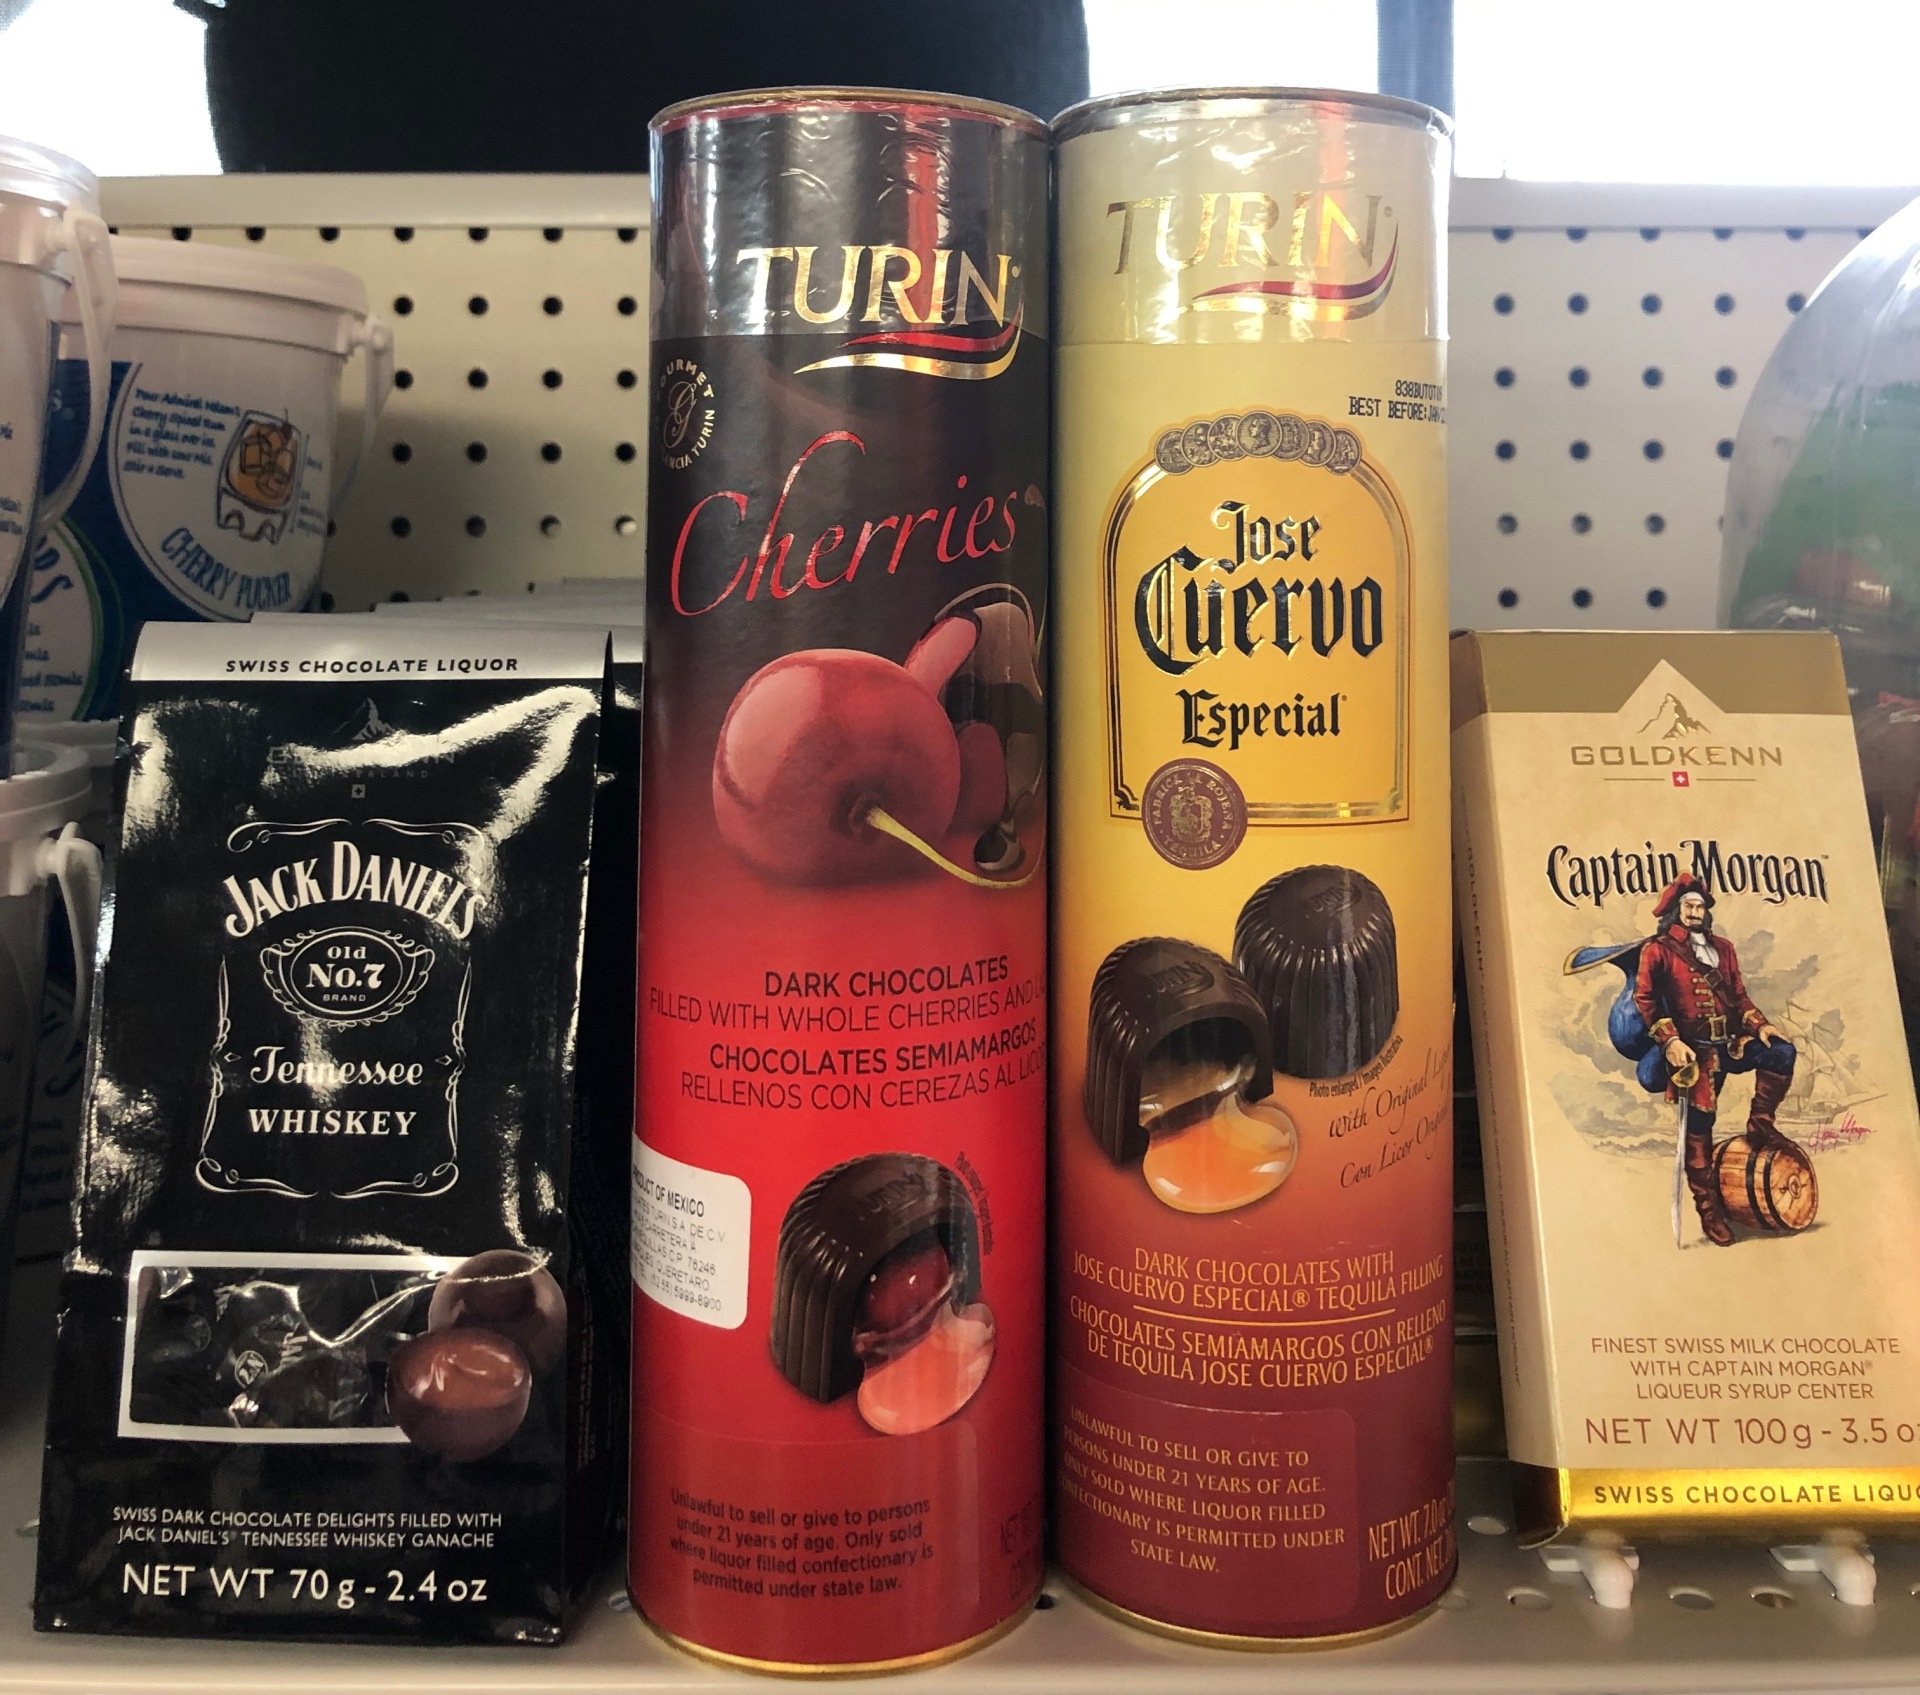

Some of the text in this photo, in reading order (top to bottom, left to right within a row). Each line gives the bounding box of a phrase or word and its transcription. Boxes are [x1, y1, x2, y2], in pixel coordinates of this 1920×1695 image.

[736, 244, 1013, 328] TURIN
[1349, 396, 1380, 418] BEST
[672, 430, 1017, 616] Cherries
[1210, 500, 1322, 574] Jose
[161, 527, 238, 601] CHERRY
[1134, 543, 1384, 676] Cuervo
[226, 658, 519, 673] SWISS CHOCOLATE LIQUOR
[1174, 689, 1341, 751] Especial
[1571, 745, 1783, 767] GOLDKENN
[1545, 839, 1828, 909] Captain Morgan
[222, 857, 327, 937] JACK
[327, 945, 367, 960] Old
[306, 963, 386, 989] No.7
[765, 972, 840, 997] DARK
[849, 955, 1008, 997] CHOCOLATES
[323, 994, 367, 1002] BRAND
[651, 987, 701, 1022] FILLED
[708, 1002, 768, 1030] WITH
[778, 1005, 879, 1032] WHOLE
[888, 990, 999, 1030] CHERRIES
[1003, 979, 1033, 1013] AND
[251, 1046, 424, 1085] Tennessee
[710, 1017, 1037, 1075] CHOCOLATES SEMIAMARGOS
[681, 1065, 1015, 1110] RELLENOS CON CEREZAS AL
[1309, 1081, 1330, 1098] Photo
[249, 1109, 418, 1135] WHISKEY
[655, 1184, 665, 1201] OF
[668, 1191, 705, 1217] MEXICO
[1073, 1250, 1104, 1285] JOSE
[1109, 1266, 1185, 1304] CUERVO
[1315, 1277, 1397, 1311] TEQUILA
[1401, 1254, 1443, 1295] FILLING
[1134, 1247, 1394, 1285] DARK CHOCOLATES WITH
[1070, 1295, 1447, 1360] CHOCOLATES SEMIAMARGOS CON RELLENO
[1591, 1338, 1900, 1354] FINEST SWISS MILK CHOCOLATE
[1088, 1329, 1109, 1358] DE
[1112, 1340, 1195, 1381] TEQUILA
[1200, 1360, 1252, 1386] JOSE
[1259, 1359, 1348, 1388] CUERVO
[1630, 1361, 1682, 1376] WITH
[1687, 1361, 1773, 1376] CAPTAIN
[1636, 1383, 1874, 1400] LIQUEUR SYRUP CENTER
[1070, 1406, 1309, 1468] UNLAWFUL TO SELL OR GIVE TO
[1585, 1418, 1651, 1444] NET
[1666, 1418, 1720, 1444] WT
[1842, 1418, 1887, 1444] 3.5
[1063, 1425, 1326, 1495] PERSONS UNDER 21 YEARS OF AGE.
[1064, 1452, 1326, 1524] ONLY SOLD WHERE LIQUOR FILLED
[1594, 1485, 1674, 1504] SWISS
[1686, 1485, 1842, 1503] CHOCOLATE
[113, 1507, 502, 1528] SWISS DARK CHOCOLATE DELIGHTS FILLED WITH
[670, 1488, 930, 1530] Unlawful to sell or give to persons
[118, 1527, 156, 1544] JACK
[242, 1531, 328, 1547] TENNESSEE
[333, 1532, 407, 1548] WHISKEY
[412, 1532, 495, 1548] GANACHE
[677, 1515, 922, 1553] under 21 years of age. Only sold
[1156, 1518, 1170, 1537] IS
[1176, 1525, 1276, 1550] PERMITTED
[1283, 1528, 1345, 1549] UNDER
[1369, 1518, 1398, 1562] NET
[670, 1536, 933, 1575] where liquor filled confectionary is
[1130, 1540, 1220, 1573] STATE LAW.
[122, 1562, 196, 1597] NET
[210, 1567, 274, 1600] WT
[387, 1570, 438, 1602] 2.4
[448, 1582, 488, 1602] oz
[693, 1568, 903, 1598] permitted under state law.
[1385, 1560, 1424, 1601] CONT.
